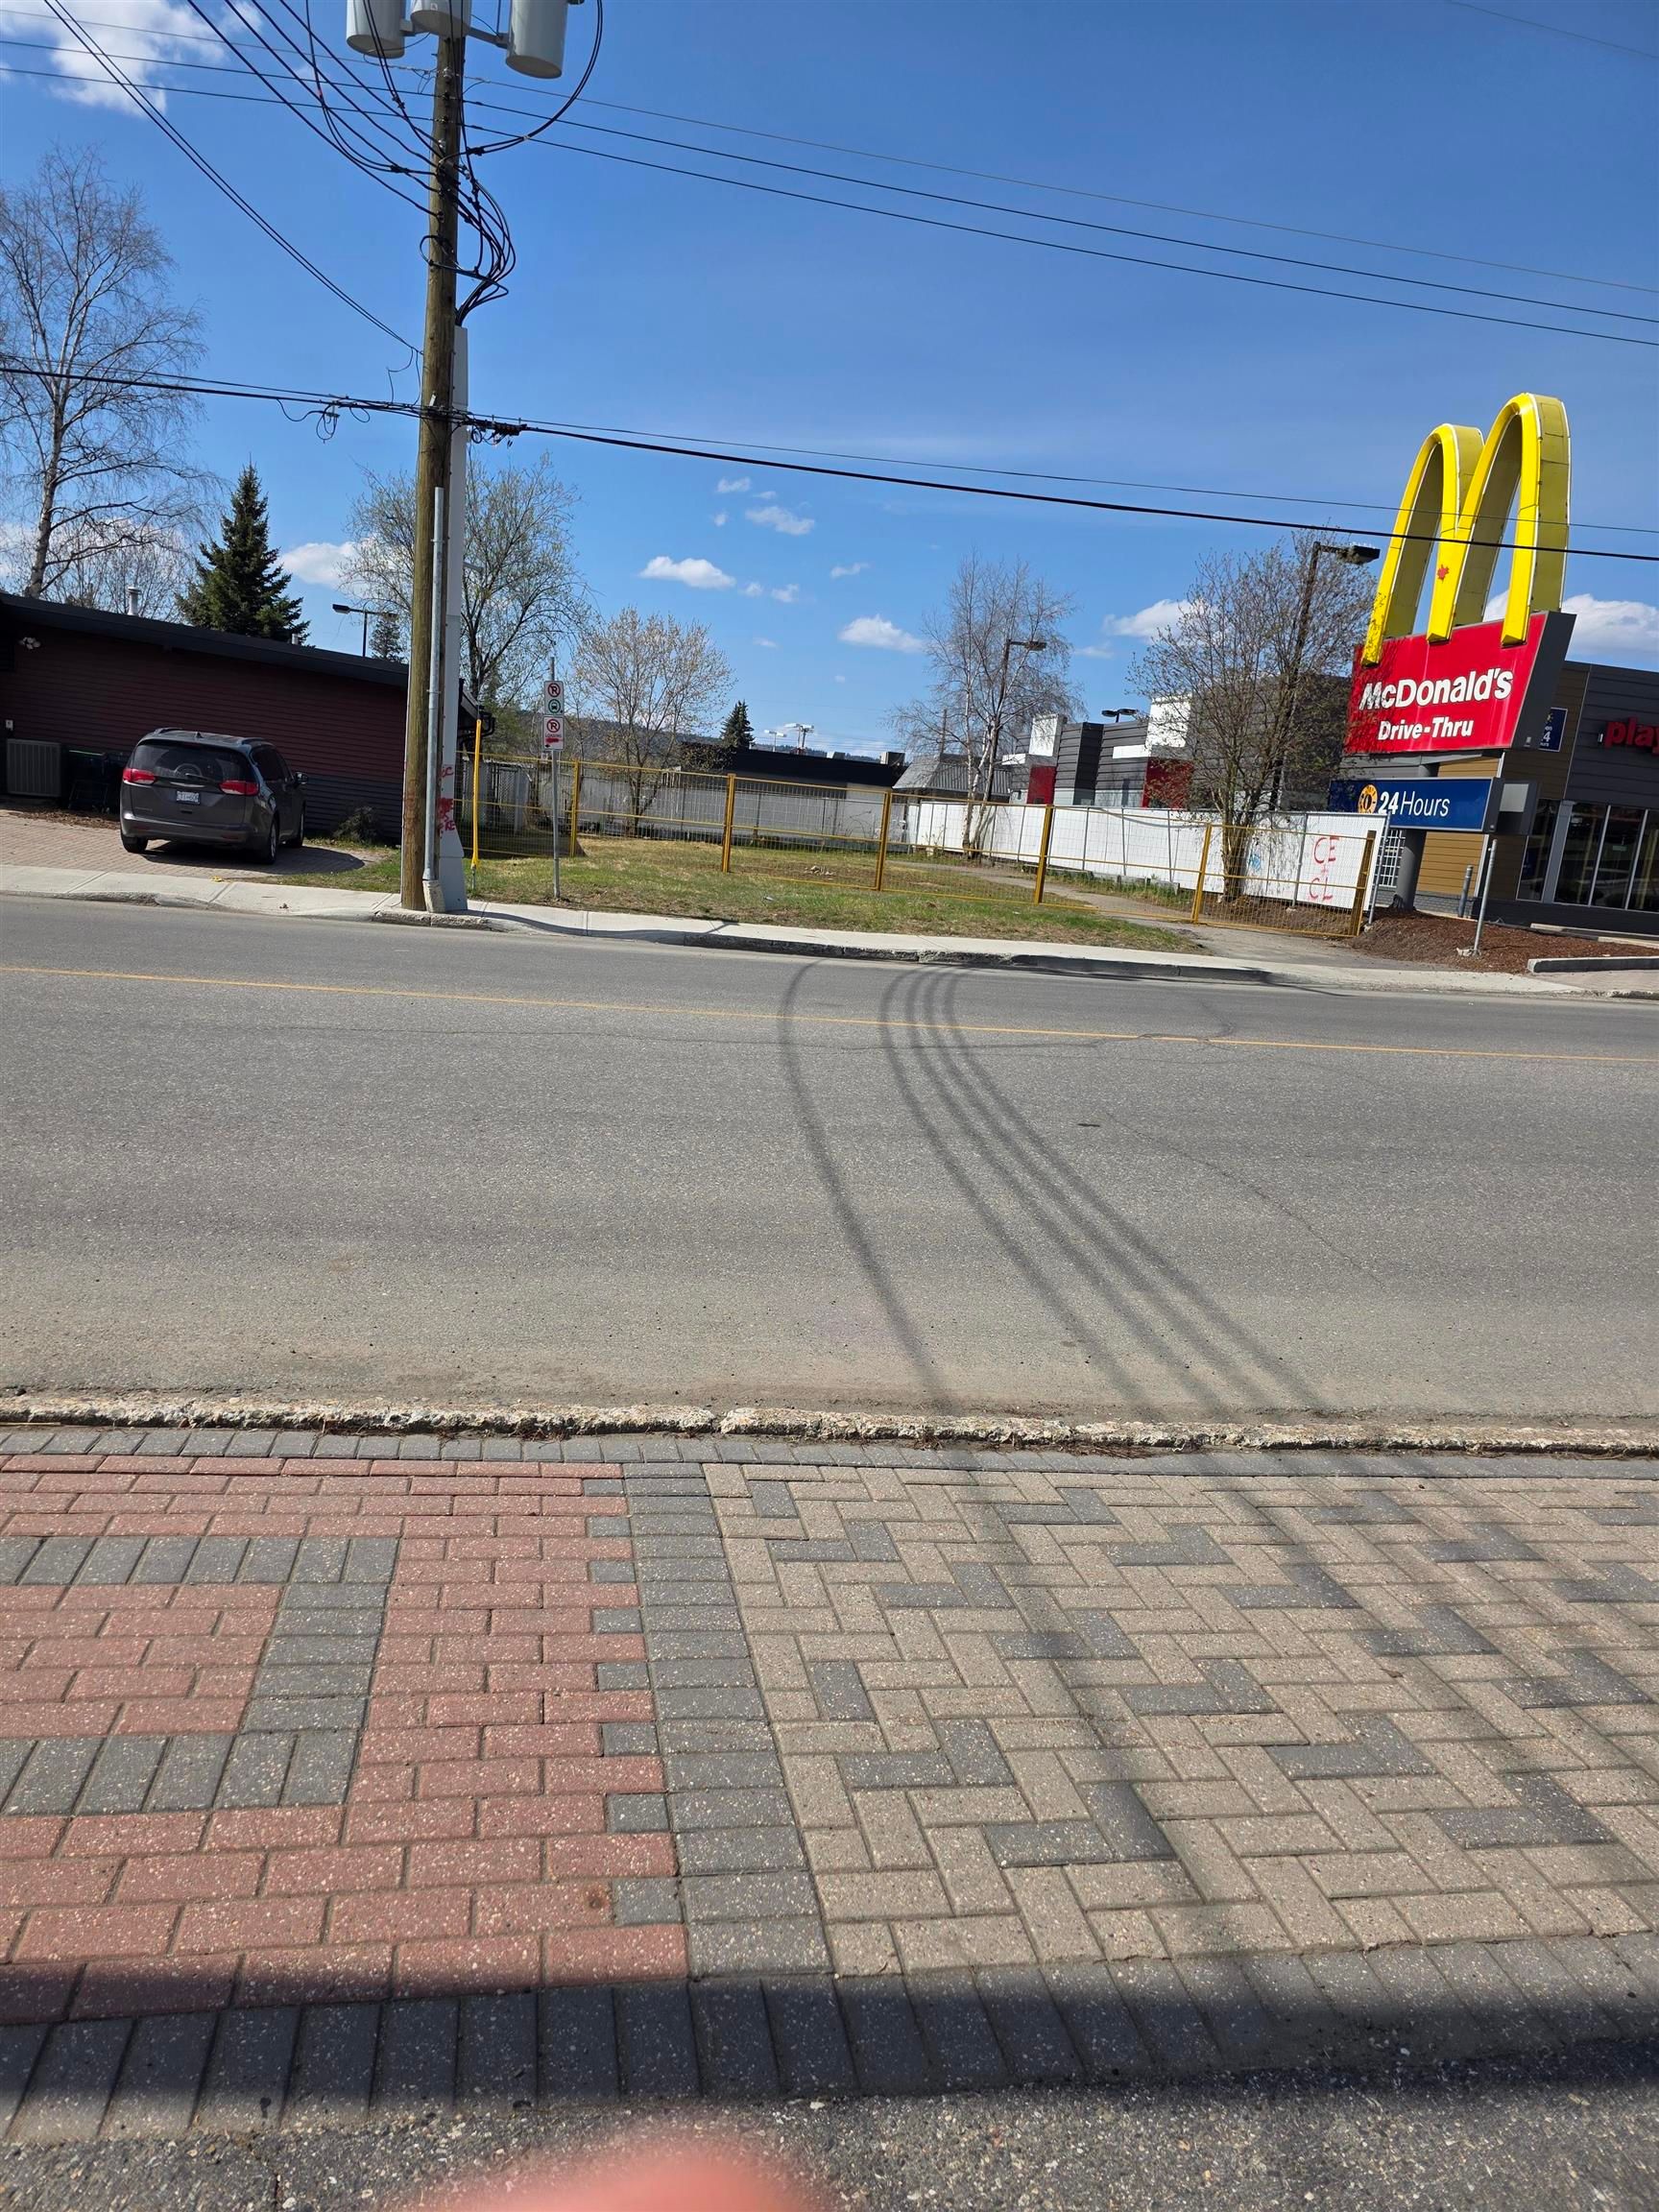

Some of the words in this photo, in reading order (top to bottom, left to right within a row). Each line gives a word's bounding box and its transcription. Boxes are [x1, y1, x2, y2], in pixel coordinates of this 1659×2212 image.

[1358, 667, 1515, 711] McDonald's
[1378, 716, 1475, 741] Drive-Thru
[1541, 731, 1551, 742] 4
[1378, 791, 1399, 815] 24
[1400, 790, 1451, 817] Hours
